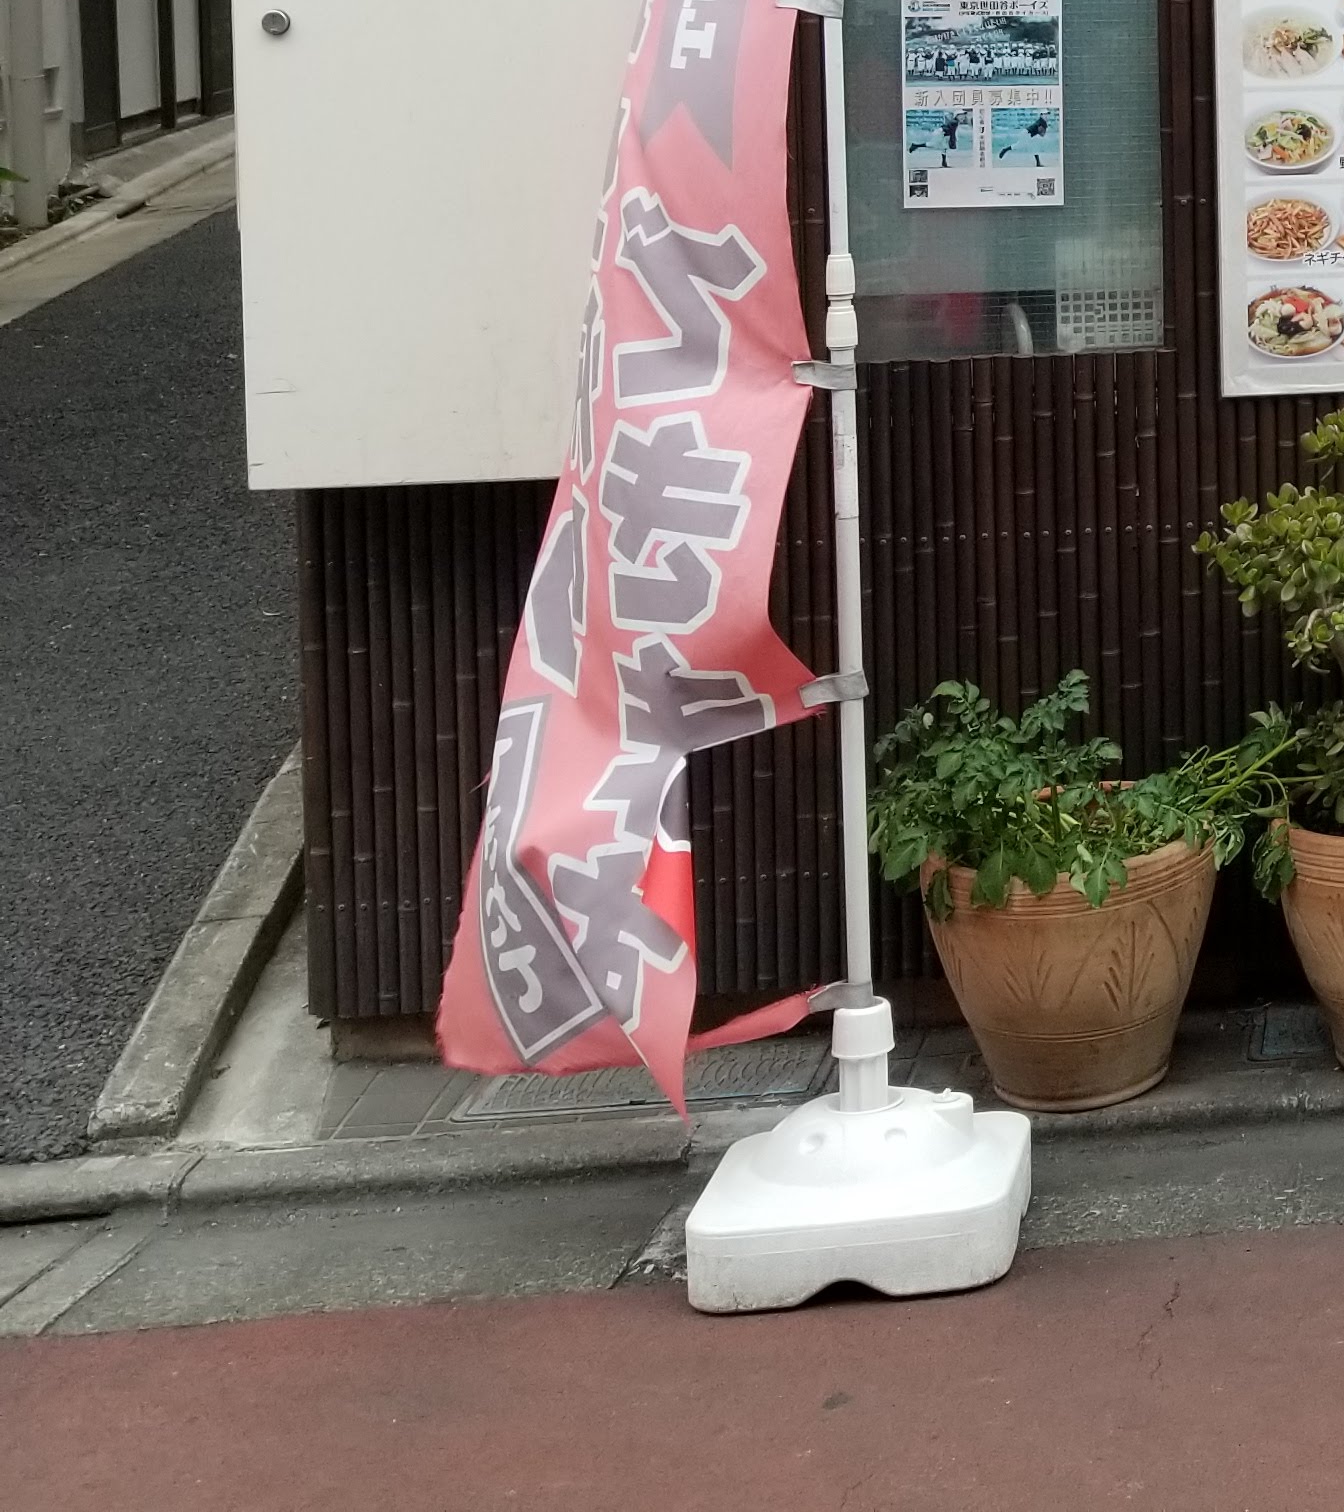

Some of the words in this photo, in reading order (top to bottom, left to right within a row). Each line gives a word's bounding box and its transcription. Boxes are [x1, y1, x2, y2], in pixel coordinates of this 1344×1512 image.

[960, 0, 1049, 11] 東京世田谷ボーイズ
